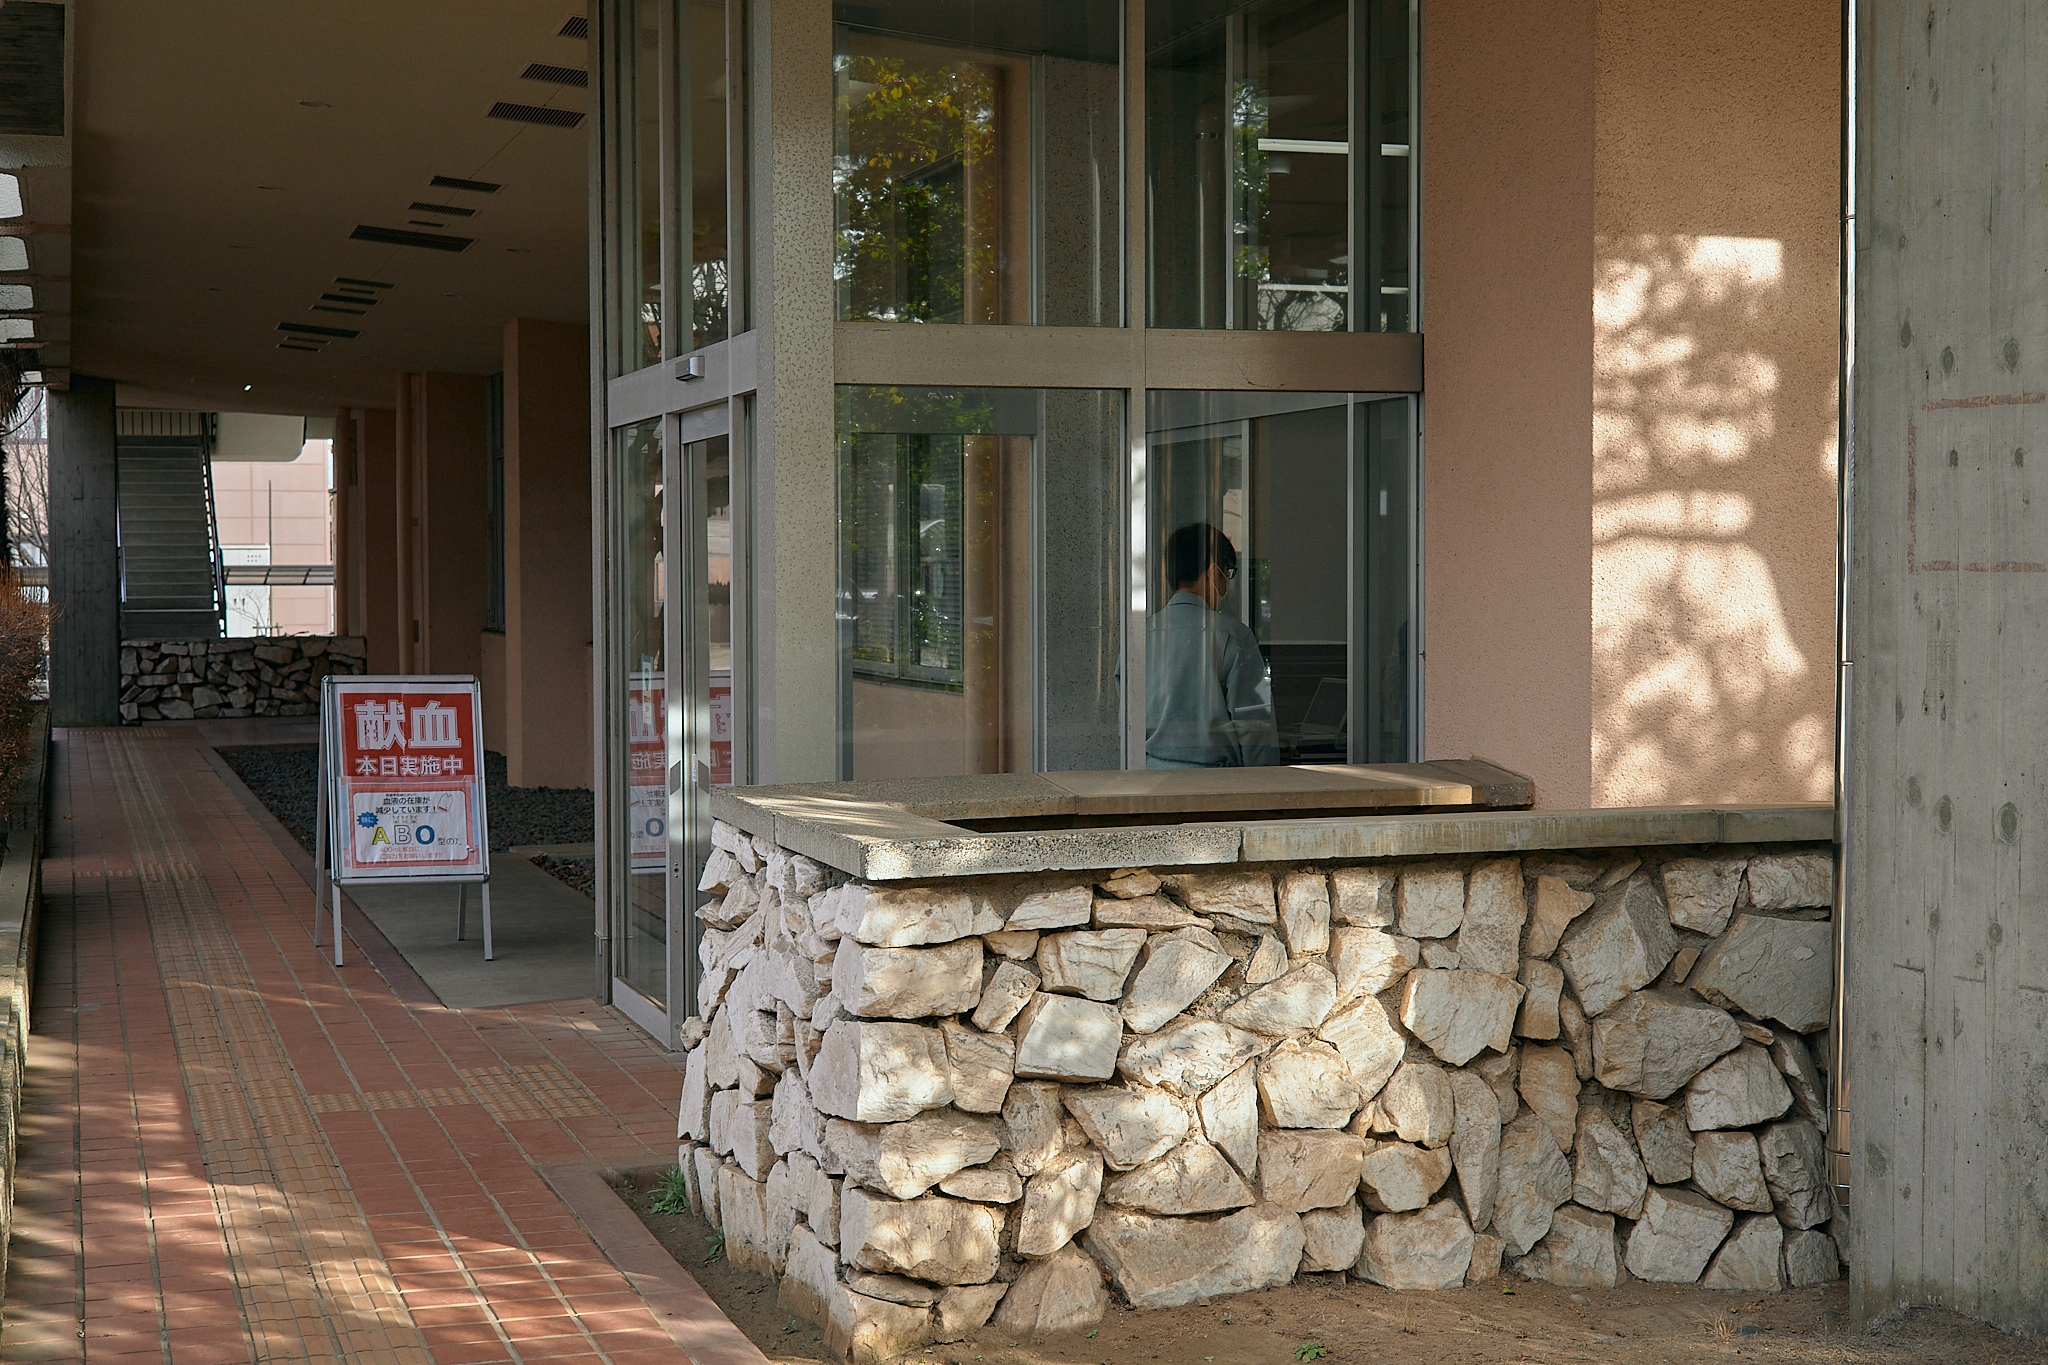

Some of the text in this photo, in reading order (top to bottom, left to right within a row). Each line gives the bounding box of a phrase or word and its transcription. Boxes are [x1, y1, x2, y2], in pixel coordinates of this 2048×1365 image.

[354, 699, 461, 751] 献血
[355, 755, 464, 777] 本日実施中
[383, 797, 431, 805] 血液の在庫が
